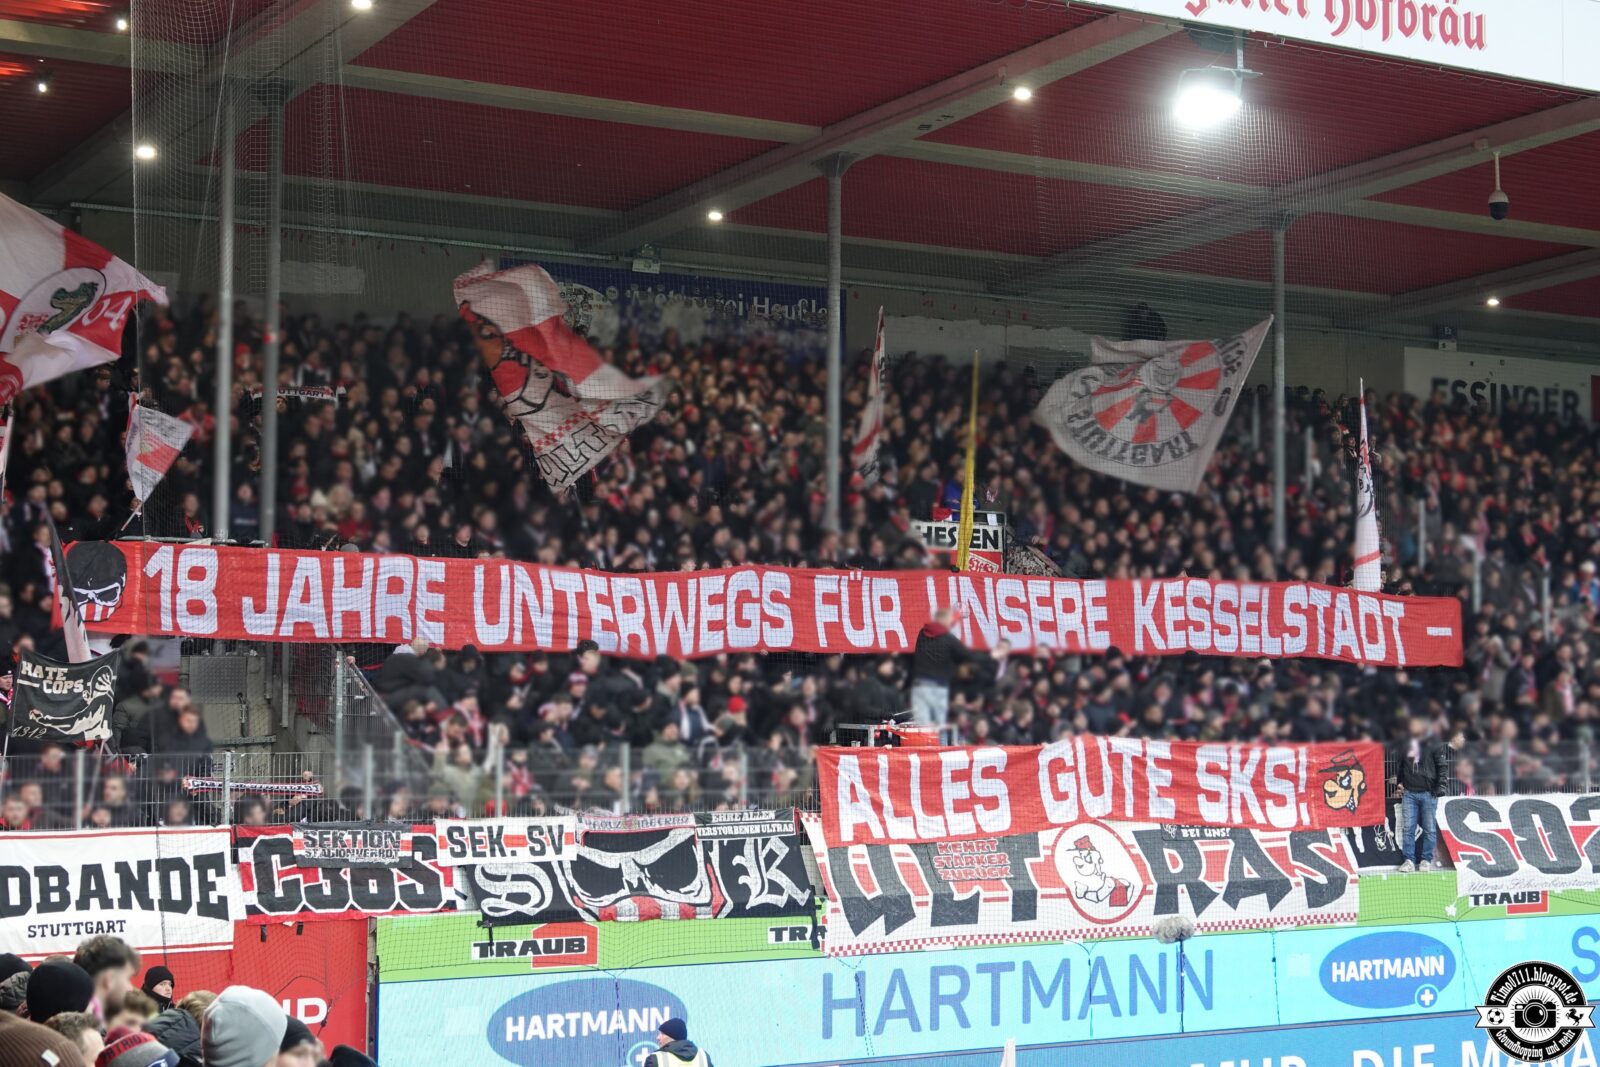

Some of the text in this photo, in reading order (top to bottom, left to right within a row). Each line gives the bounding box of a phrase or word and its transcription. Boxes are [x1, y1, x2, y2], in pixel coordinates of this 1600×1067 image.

[1431, 377, 1579, 420] ESSINGER
[918, 525, 999, 549] HESEN
[143, 545, 219, 635] 18
[241, 553, 446, 645] JAHRE
[473, 564, 794, 656] UNTERWEGS
[814, 570, 909, 649] FÜR
[926, 576, 1111, 650] UNSERE
[1133, 580, 1408, 665] KESSELSTADT
[21, 660, 68, 681] HATE
[43, 679, 84, 694] COPS
[837, 748, 1012, 842] ALLES
[1038, 734, 1176, 824] GUTE
[1195, 744, 1311, 828] SKS!
[742, 811, 776, 822] ALLEN
[303, 829, 401, 849] SEKTION
[762, 823, 794, 835] ULTRAS
[1181, 828, 1200, 838] BEI
[527, 825, 564, 856] SV
[937, 838, 998, 854] KEHRT
[1470, 890, 1541, 906] TRAUB
[28, 919, 126, 938] STUTTGART
[473, 936, 586, 958] TRAUB
[1331, 955, 1445, 983] HARTMANN
[821, 949, 1214, 1040] HARTMANN
[505, 1006, 670, 1042] HARTMANN
